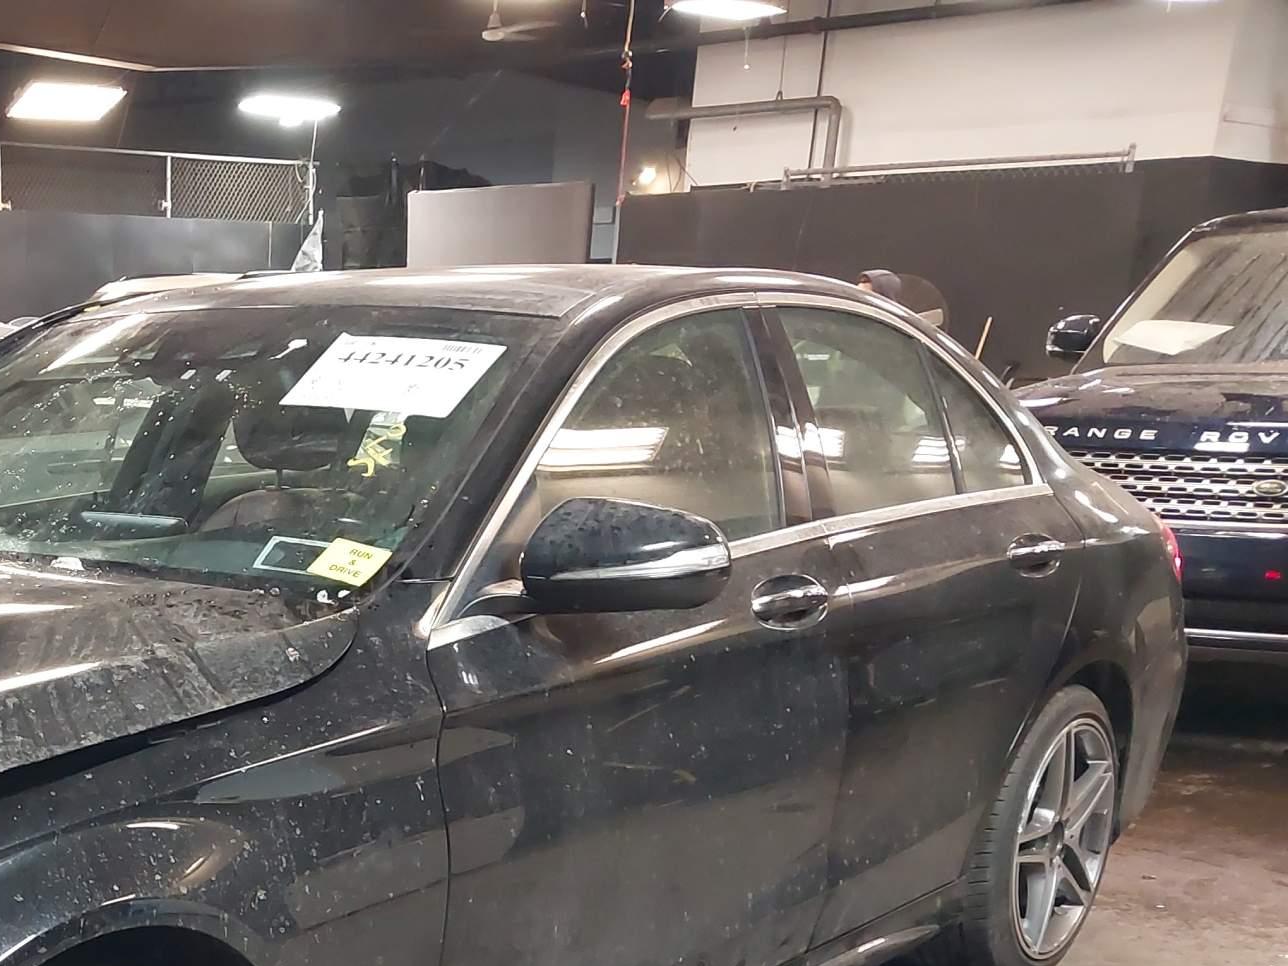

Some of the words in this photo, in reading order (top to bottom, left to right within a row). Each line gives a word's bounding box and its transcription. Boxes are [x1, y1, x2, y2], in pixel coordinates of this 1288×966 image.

[338, 351, 470, 371] 44241205
[349, 548, 373, 560] RUN
[328, 564, 361, 578] DRIVE
